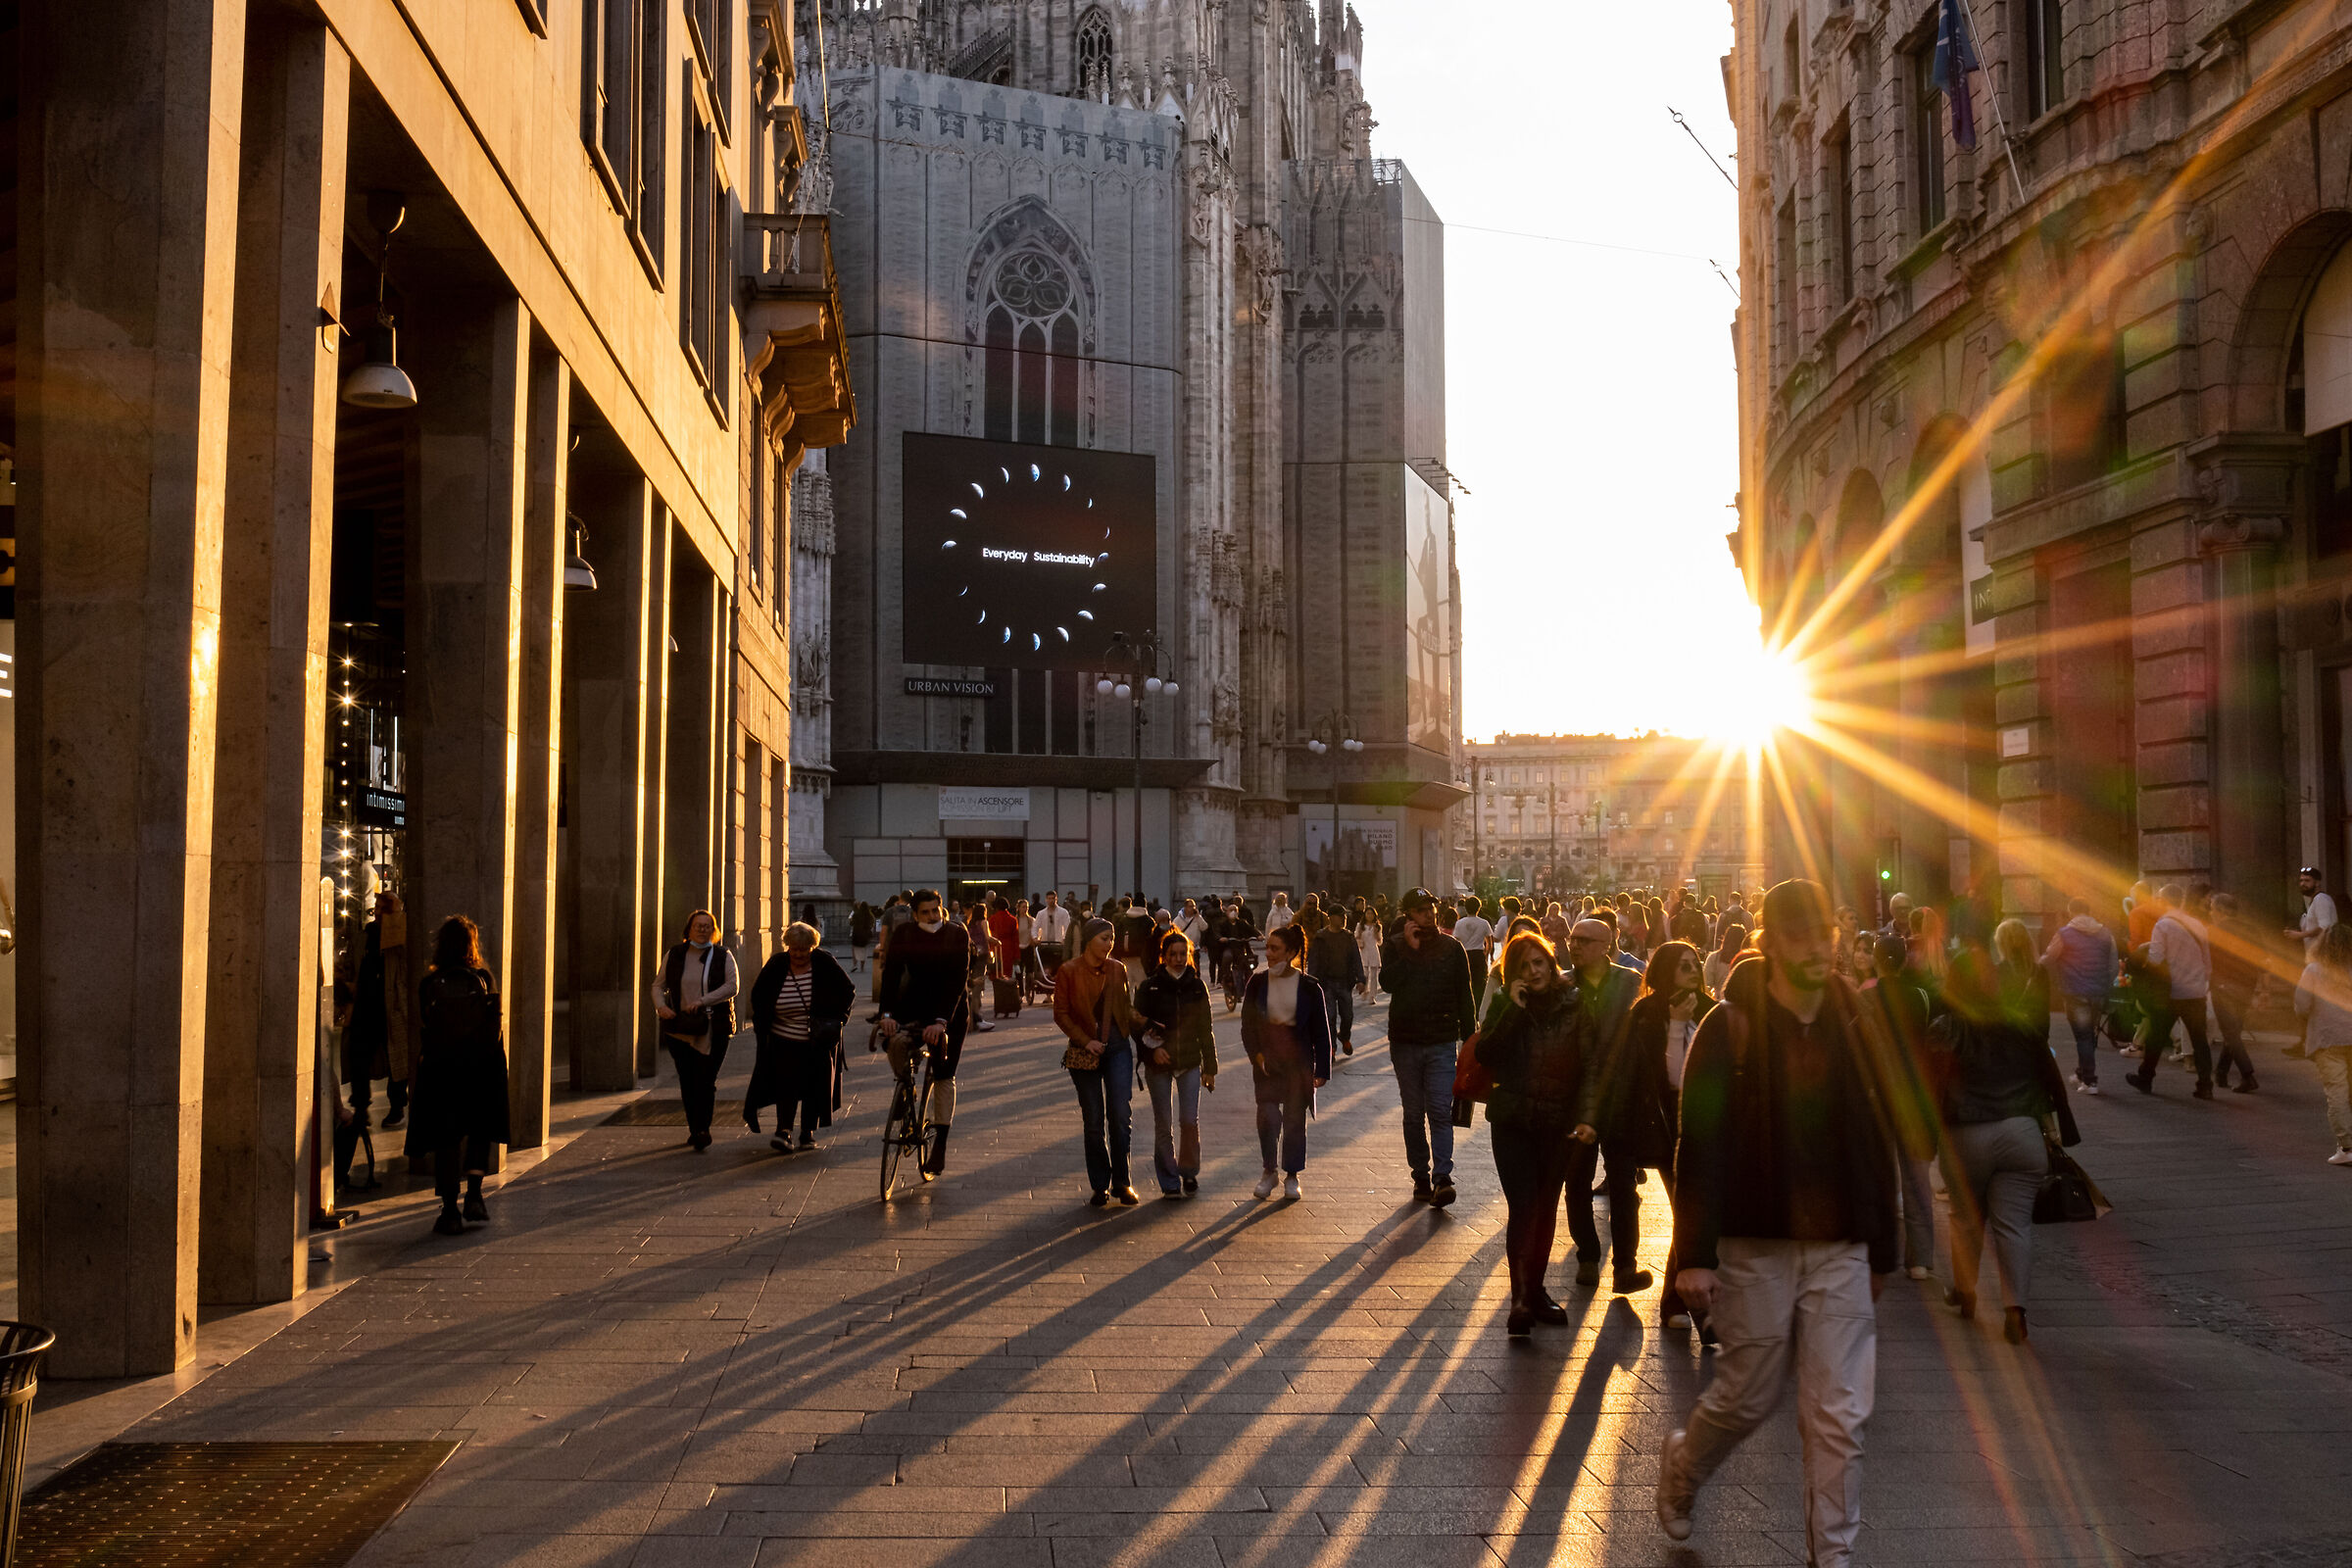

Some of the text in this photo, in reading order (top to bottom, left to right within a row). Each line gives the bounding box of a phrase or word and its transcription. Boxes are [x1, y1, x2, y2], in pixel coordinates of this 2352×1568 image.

[983, 548, 1095, 567] Everyday Sustainability
[908, 681, 994, 694] URBAN VISION
[367, 792, 405, 812] intimissimi
[978, 797, 1024, 806] ASCENSORE
